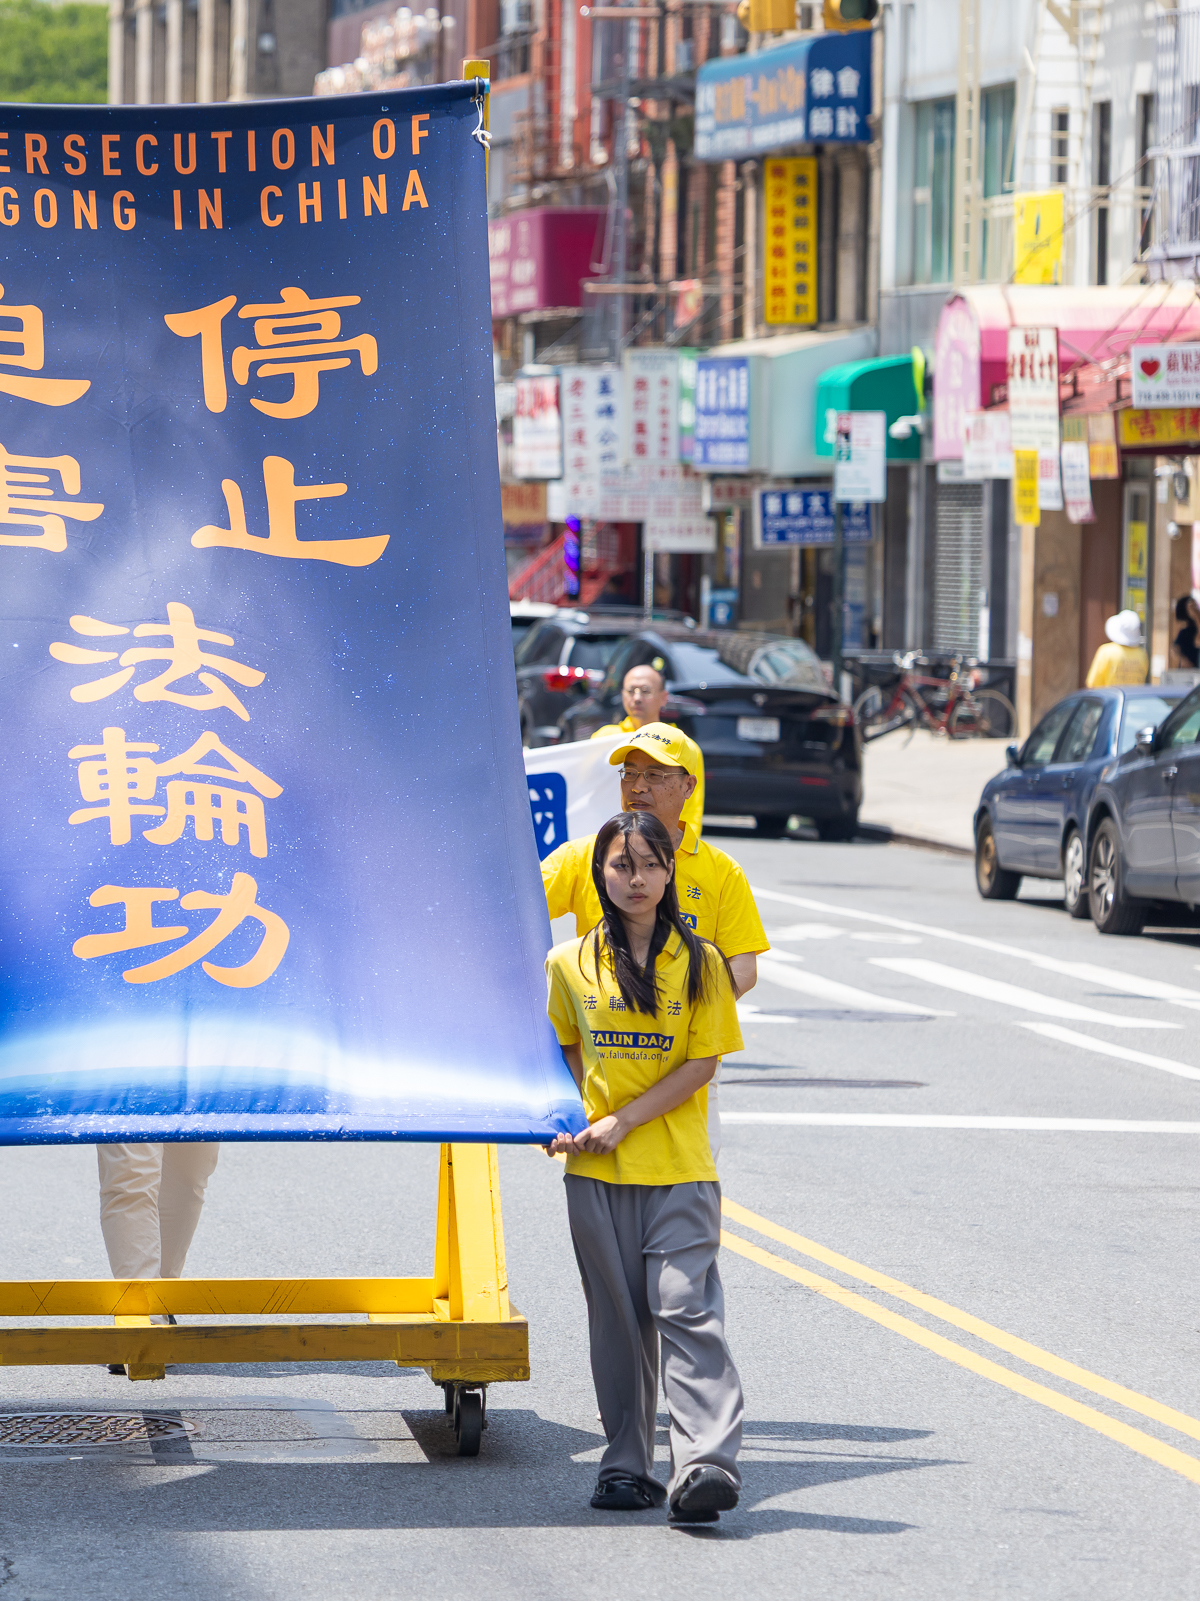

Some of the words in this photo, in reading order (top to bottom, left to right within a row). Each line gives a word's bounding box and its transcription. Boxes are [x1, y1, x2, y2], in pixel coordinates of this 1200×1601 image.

[372, 113, 430, 160] OF
[173, 188, 223, 230] IN
[260, 169, 429, 227] CHINA
[164, 287, 390, 567] 停止
[49, 602, 290, 988] 法輪功
[583, 994, 683, 1016] 法輪法
[591, 1032, 634, 1046] FALUN
[638, 1034, 670, 1050] DAFA
